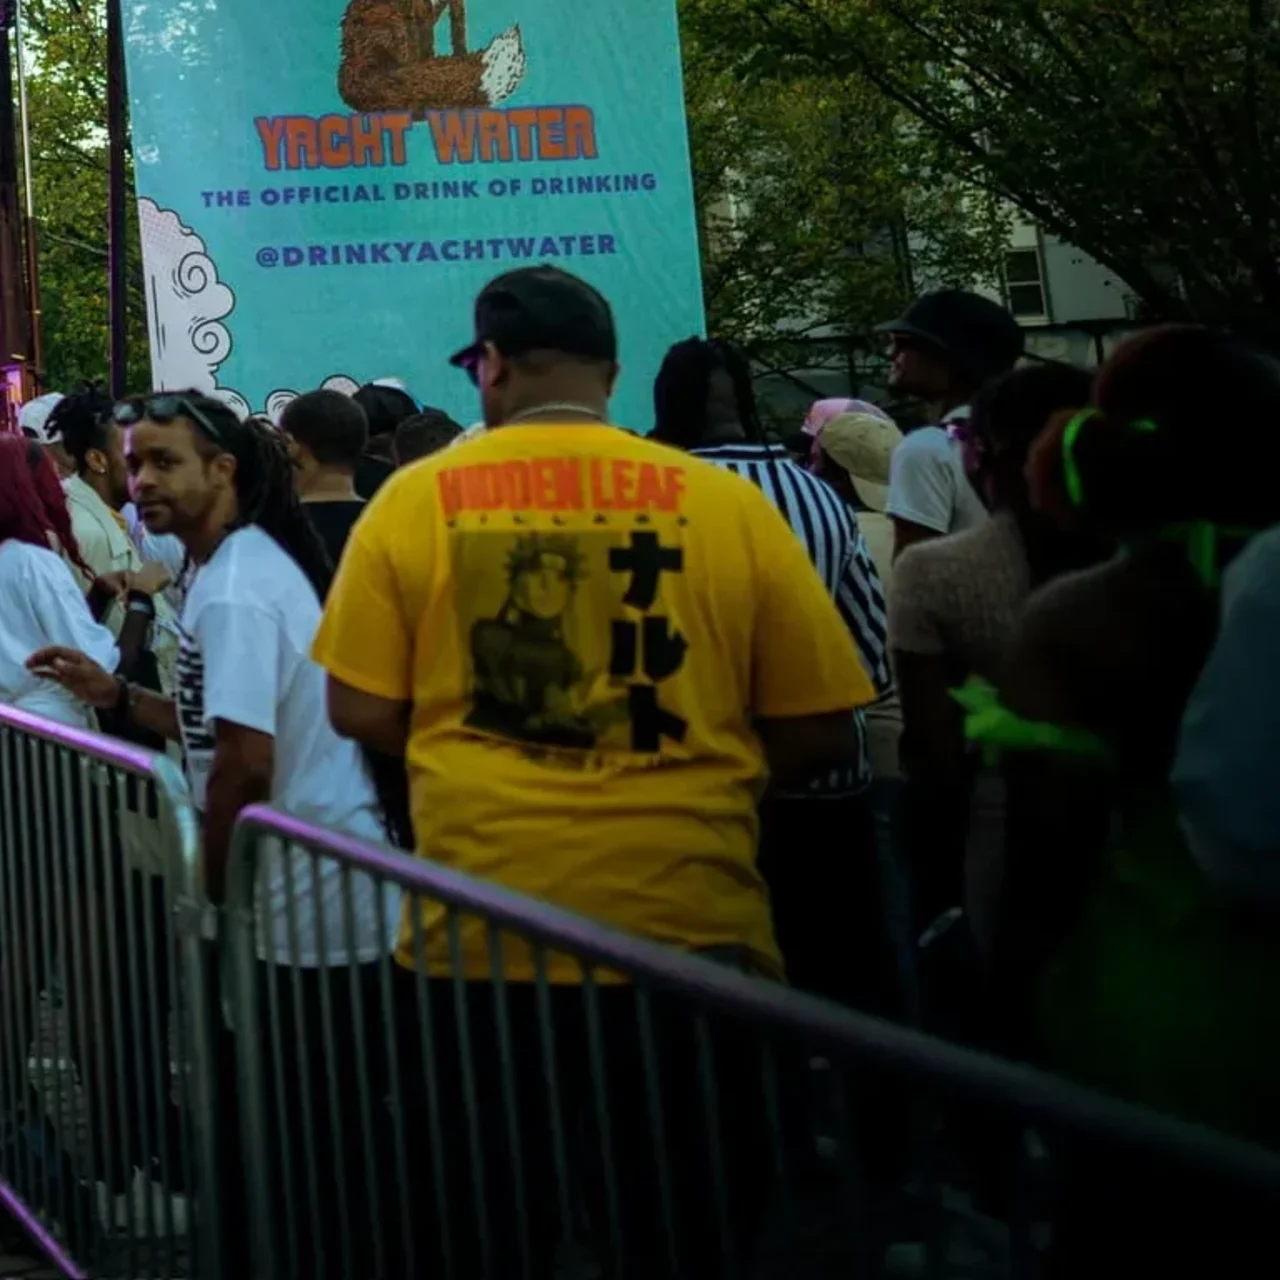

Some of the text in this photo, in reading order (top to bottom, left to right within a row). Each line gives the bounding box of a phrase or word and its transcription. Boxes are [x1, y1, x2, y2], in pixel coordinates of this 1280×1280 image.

[254, 104, 598, 170] YACHT WATER
[201, 173, 656, 208] THE OFFICIAL DRINK OF DRINKING
[256, 234, 616, 268] @DRINKYACHTWATER
[590, 458, 686, 511] LEAF
[608, 531, 688, 752] ナルト
